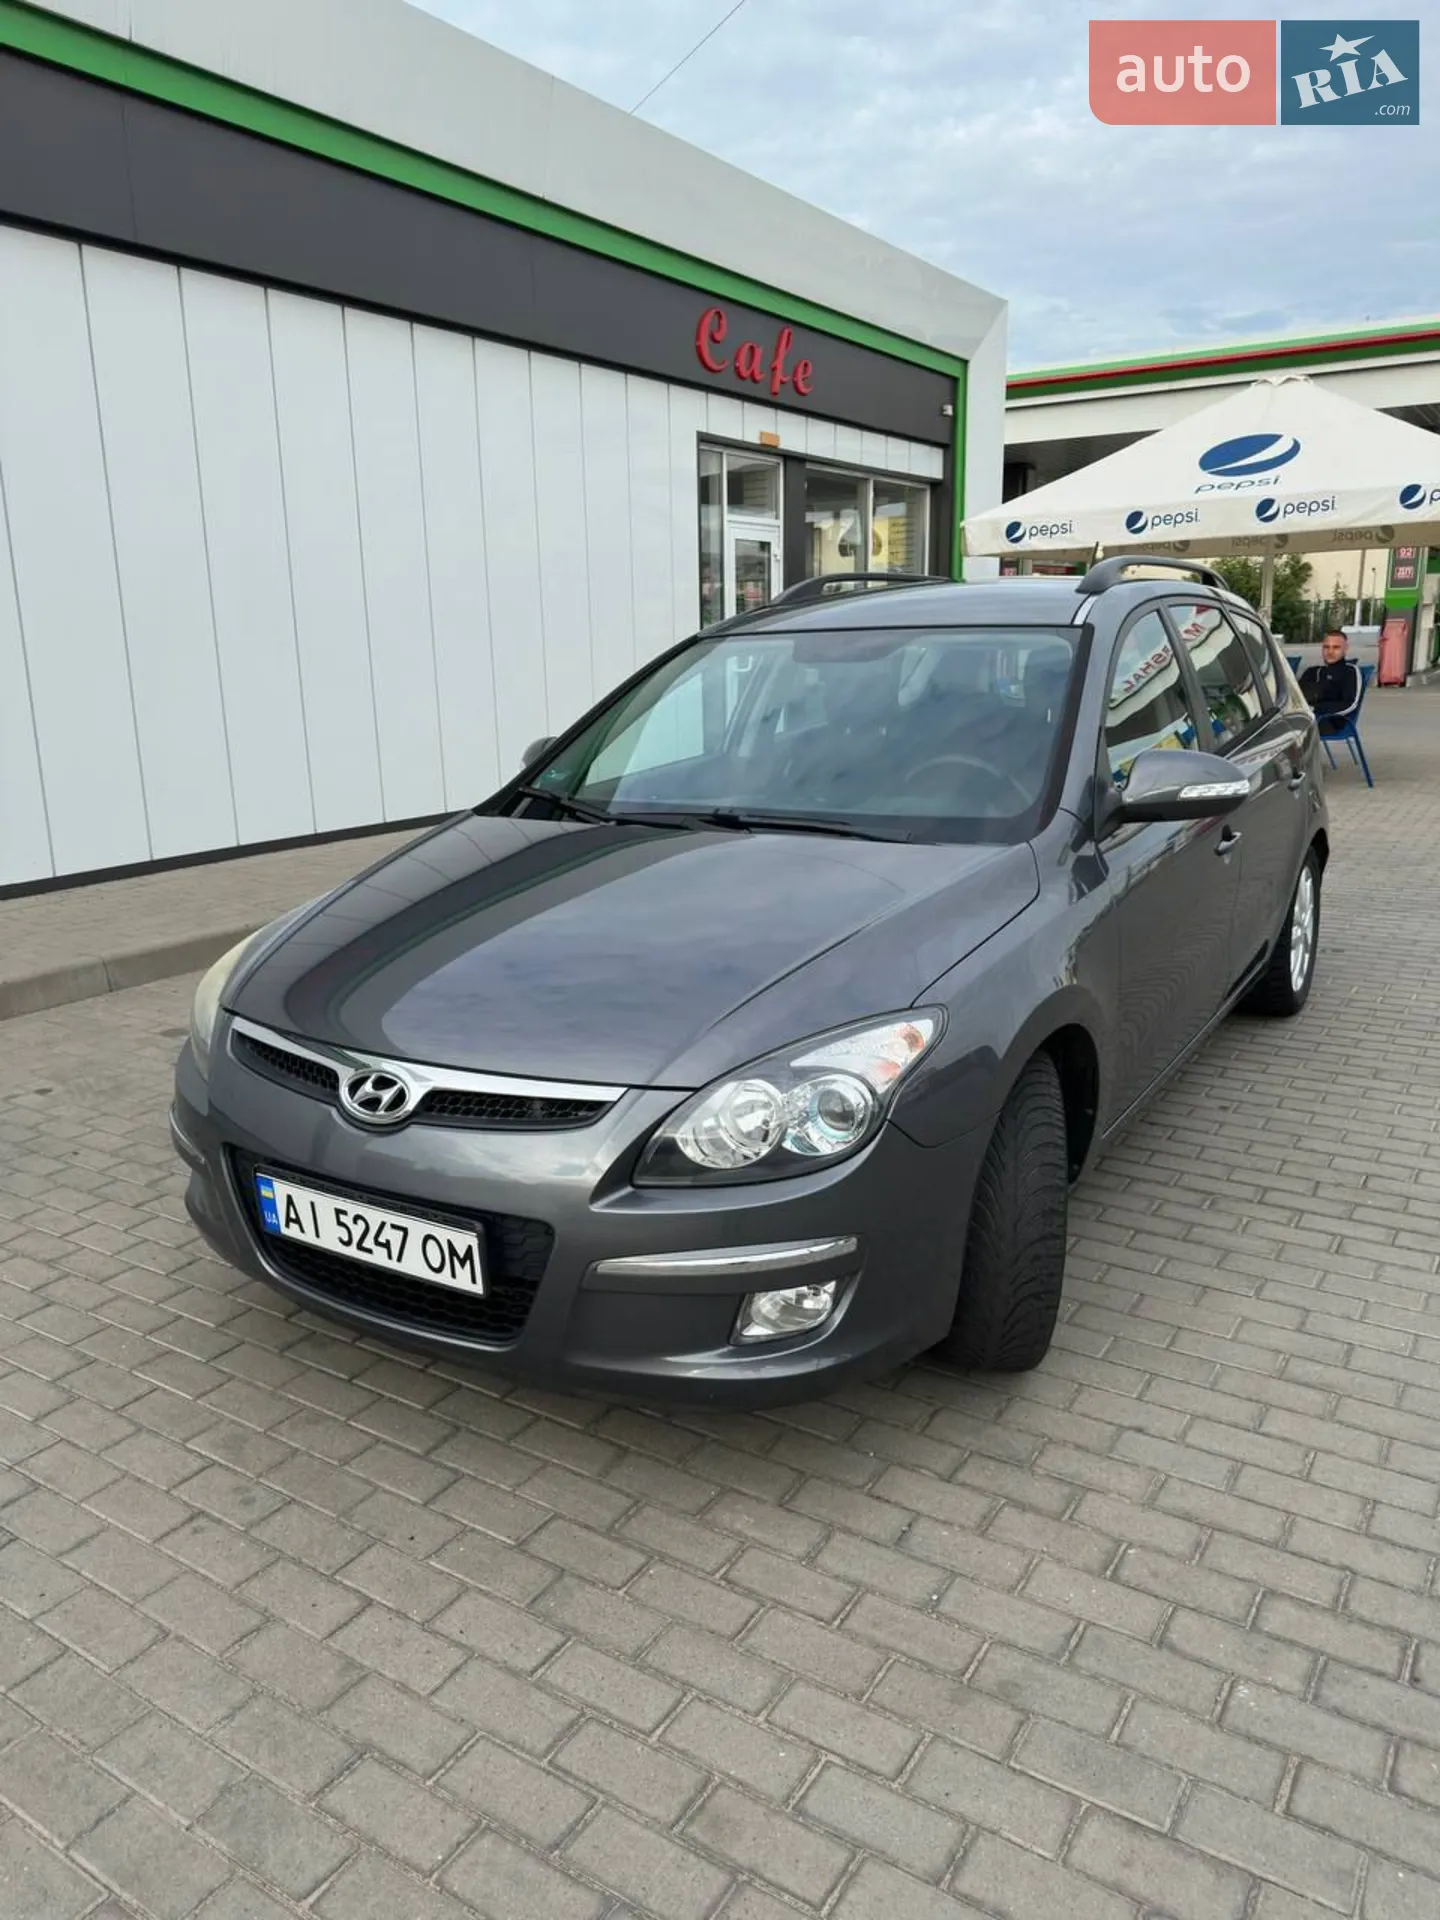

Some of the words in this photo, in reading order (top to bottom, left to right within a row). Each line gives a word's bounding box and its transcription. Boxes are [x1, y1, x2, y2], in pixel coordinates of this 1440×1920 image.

[695, 306, 814, 397] Cafe
[1194, 474, 1281, 494] pepsi
[1028, 520, 1073, 539] pepsi
[1150, 508, 1199, 529] pepsi
[1282, 495, 1336, 518] pepsi
[263, 1210, 279, 1226] UA
[284, 1193, 321, 1239] AI
[333, 1206, 409, 1264] 5247
[421, 1233, 478, 1286] OM
